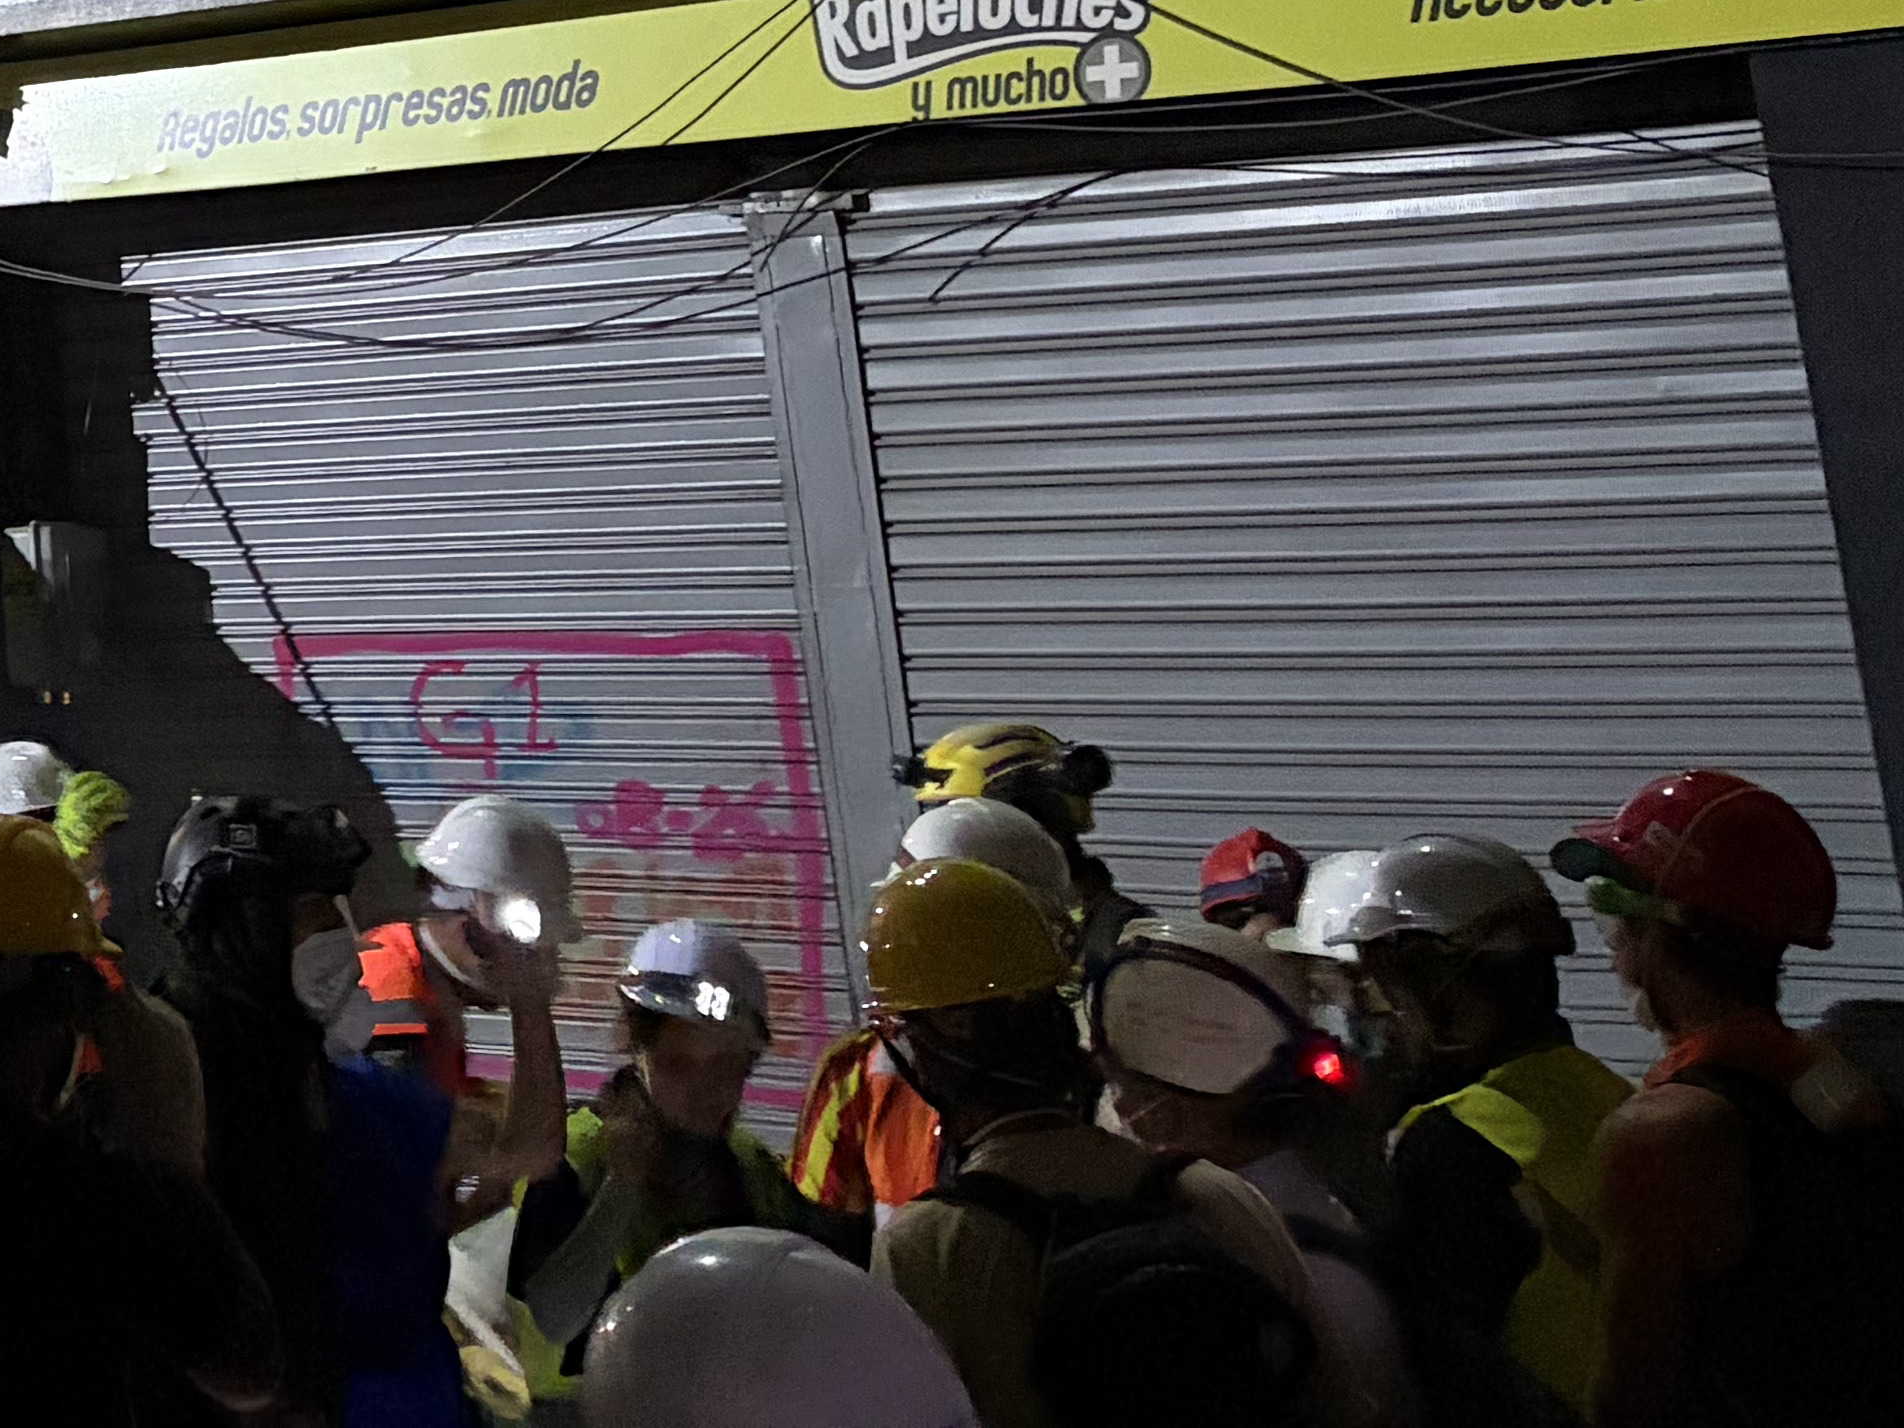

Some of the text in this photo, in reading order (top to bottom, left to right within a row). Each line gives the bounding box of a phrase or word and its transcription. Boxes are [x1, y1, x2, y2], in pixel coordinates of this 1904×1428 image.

[157, 58, 600, 159] Regalos, sorpresas, moda
[911, 80, 933, 121] y
[946, 56, 1070, 111] mucho
